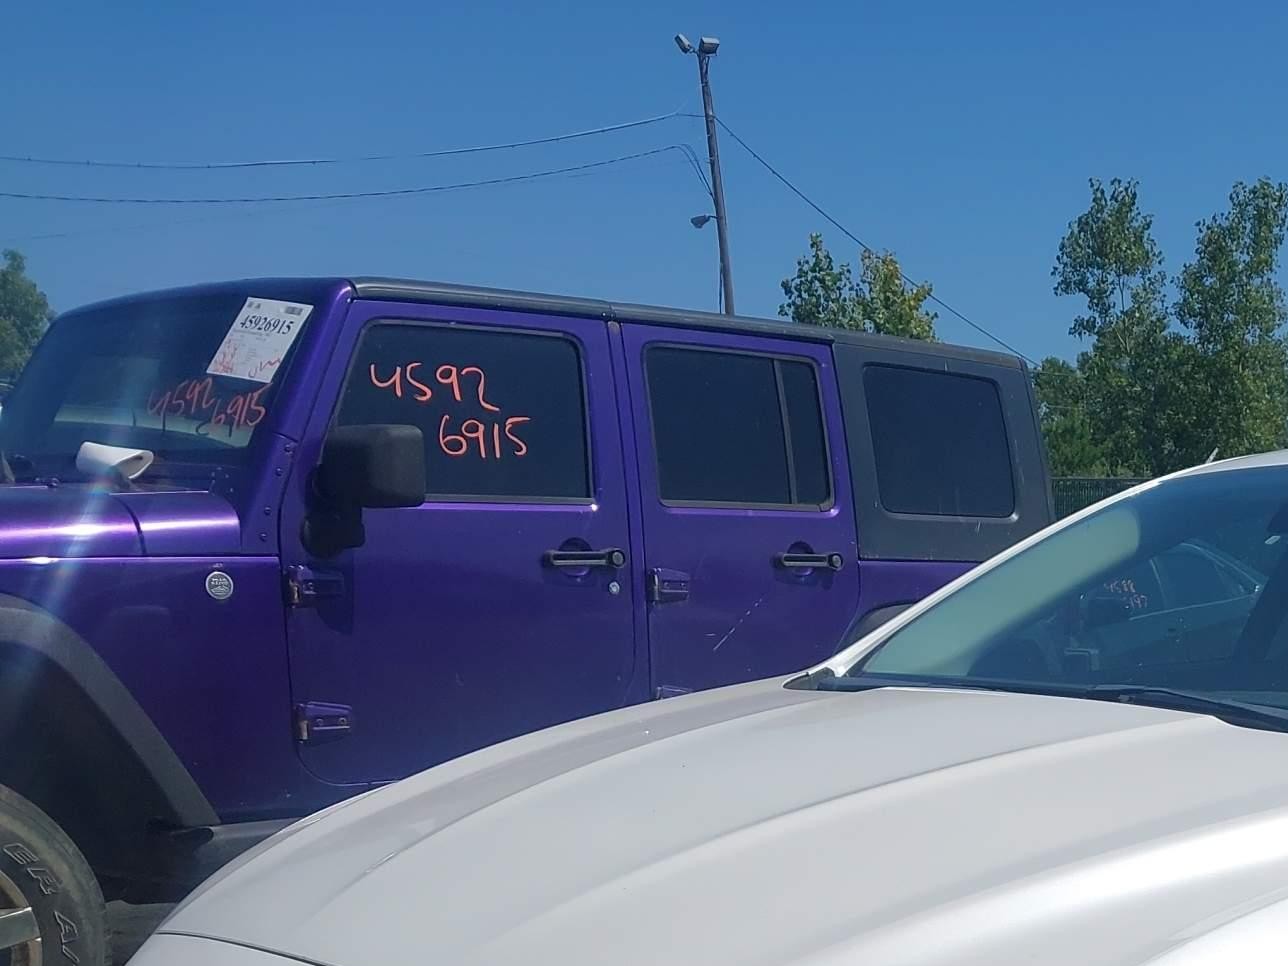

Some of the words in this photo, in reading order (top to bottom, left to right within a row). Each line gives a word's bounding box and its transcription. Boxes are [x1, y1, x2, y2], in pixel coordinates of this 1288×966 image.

[239, 314, 295, 335] 45926915
[368, 361, 501, 412] 4592
[438, 414, 532, 459] 6915
